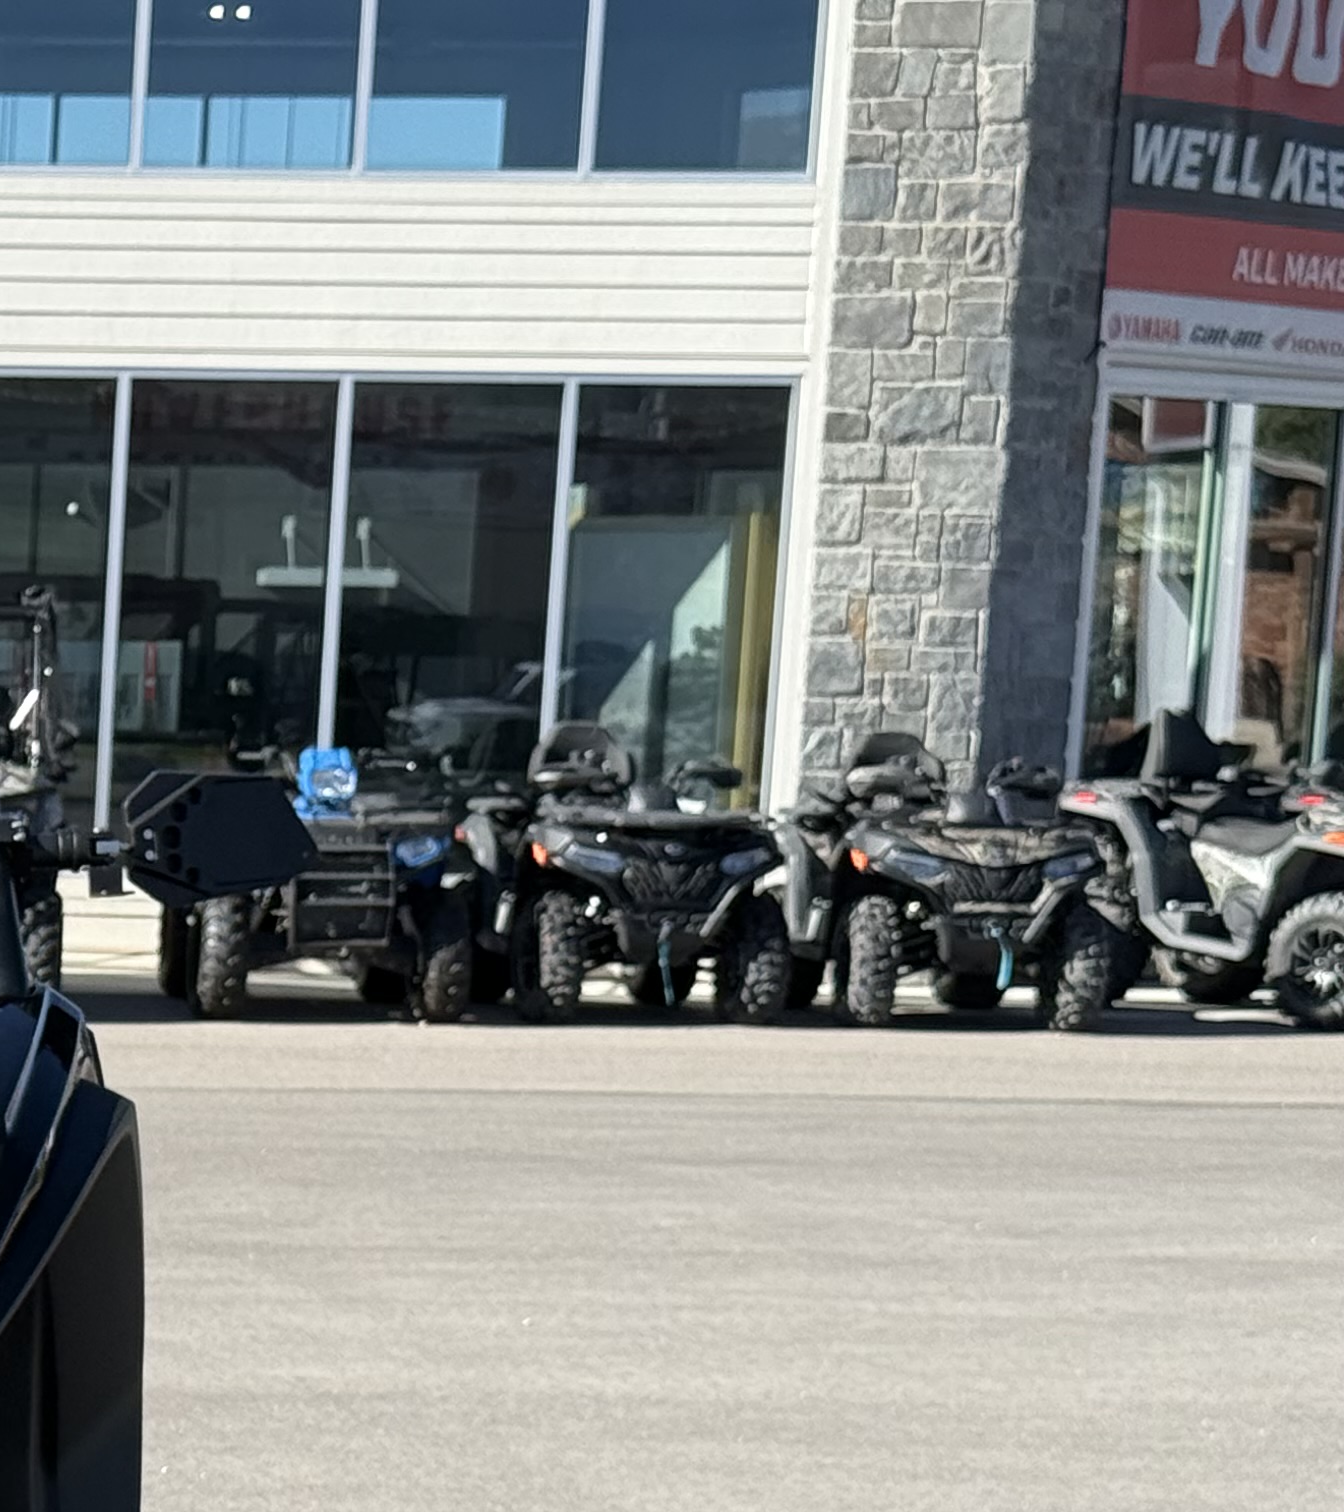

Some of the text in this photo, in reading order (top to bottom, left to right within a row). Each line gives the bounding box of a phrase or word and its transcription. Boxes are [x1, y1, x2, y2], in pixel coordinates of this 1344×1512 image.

[1131, 121, 1262, 199] WE'LL
[1232, 246, 1279, 286] ALL
[1123, 314, 1181, 341] YAMAHA
